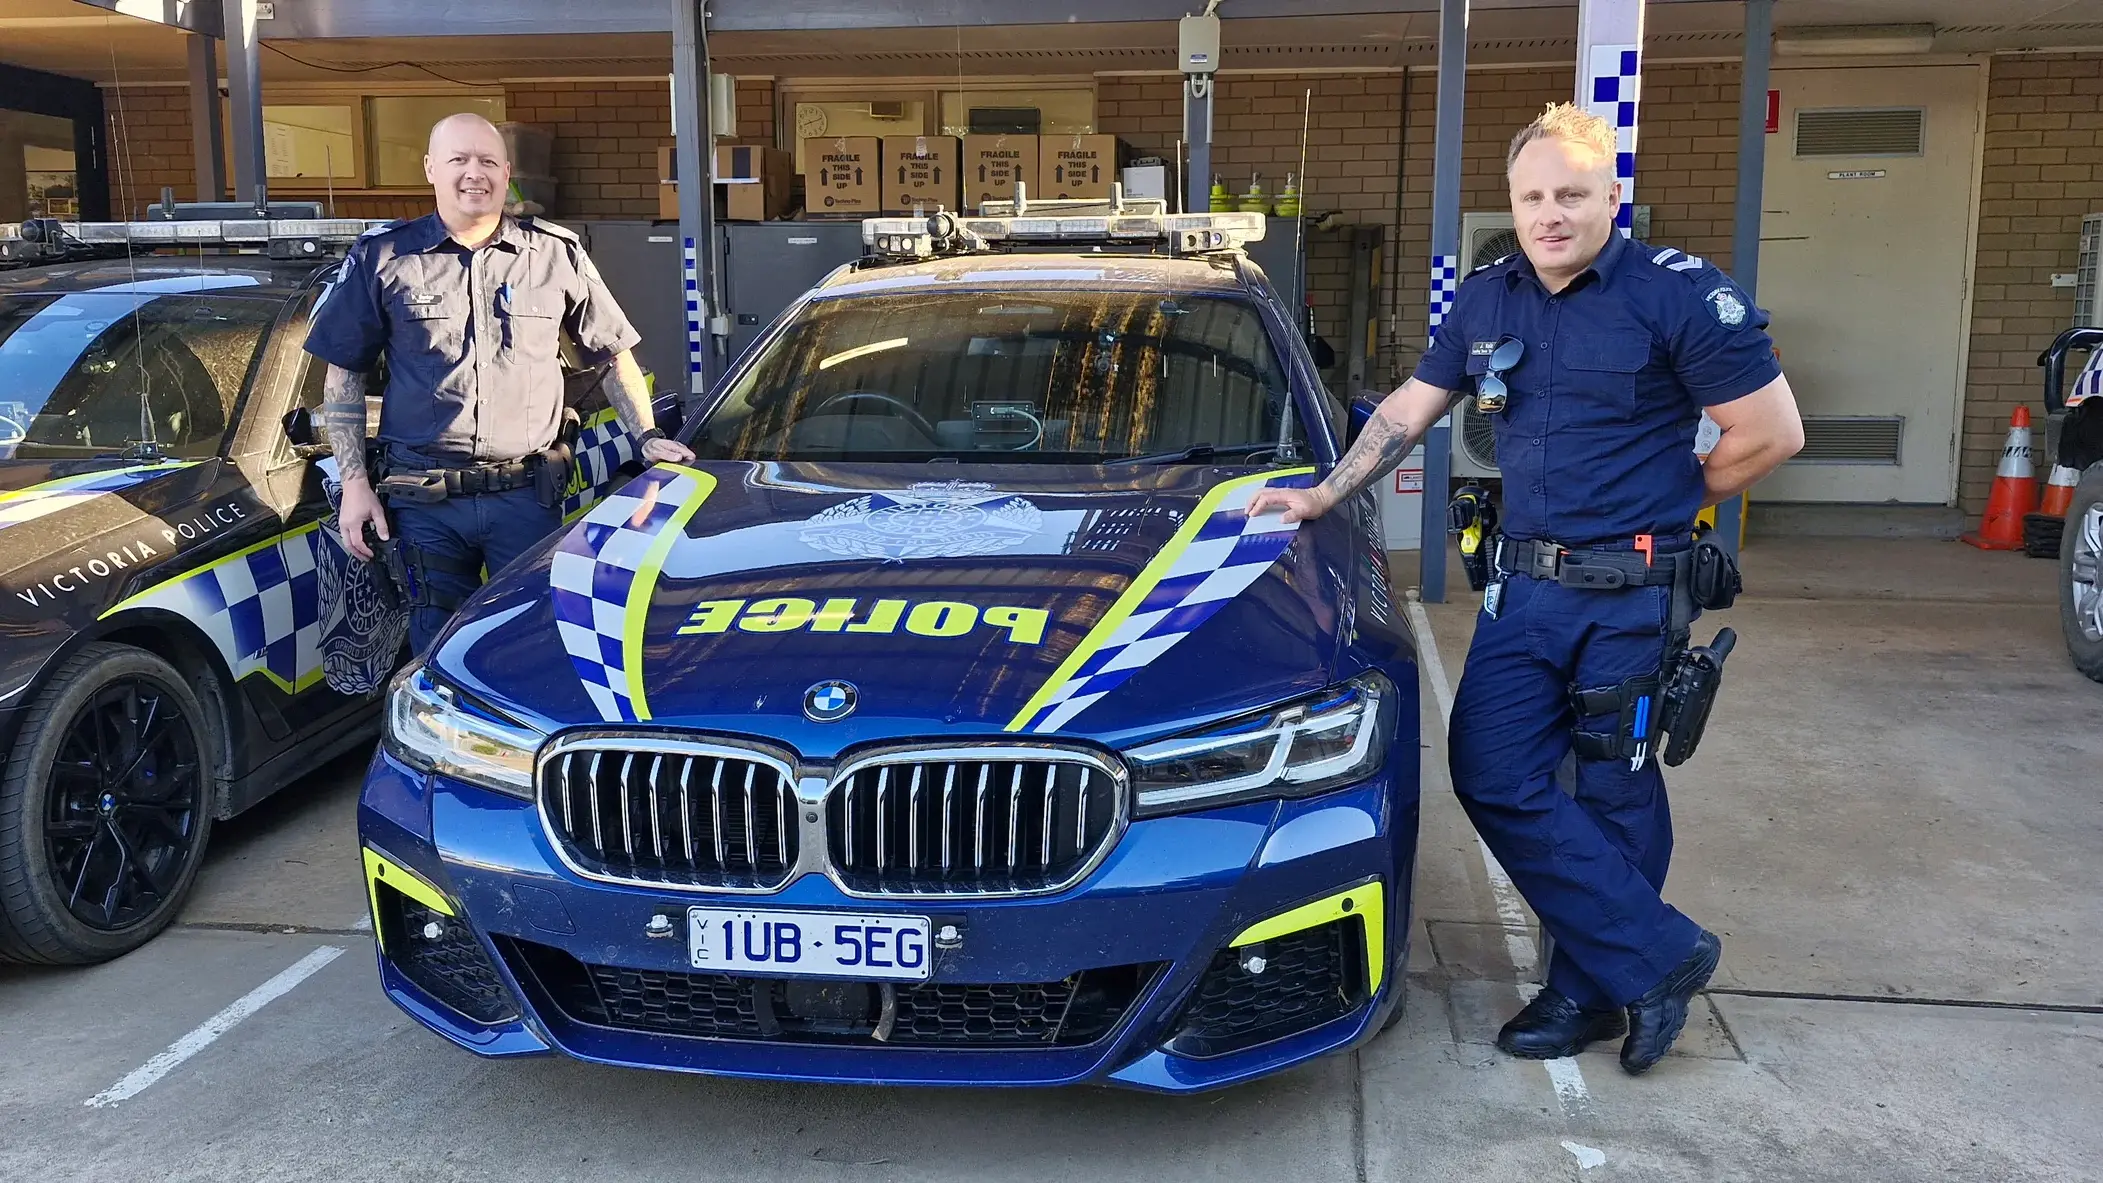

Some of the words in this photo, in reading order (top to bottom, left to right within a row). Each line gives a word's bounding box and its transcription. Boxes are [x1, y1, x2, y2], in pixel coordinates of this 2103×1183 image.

[822, 154, 860, 162] FRAGILE
[900, 152, 938, 161] FRAGILE
[1057, 151, 1097, 159] FRAGILE
[832, 173, 851, 181] SIDE
[16, 539, 158, 608] VICTORIA
[161, 502, 246, 546] POLICE
[334, 641, 360, 658] UPHOLD
[361, 642, 377, 657] THE
[697, 919, 709, 960] VIC
[722, 920, 801, 963] 1UB
[834, 925, 923, 968] 5EG
